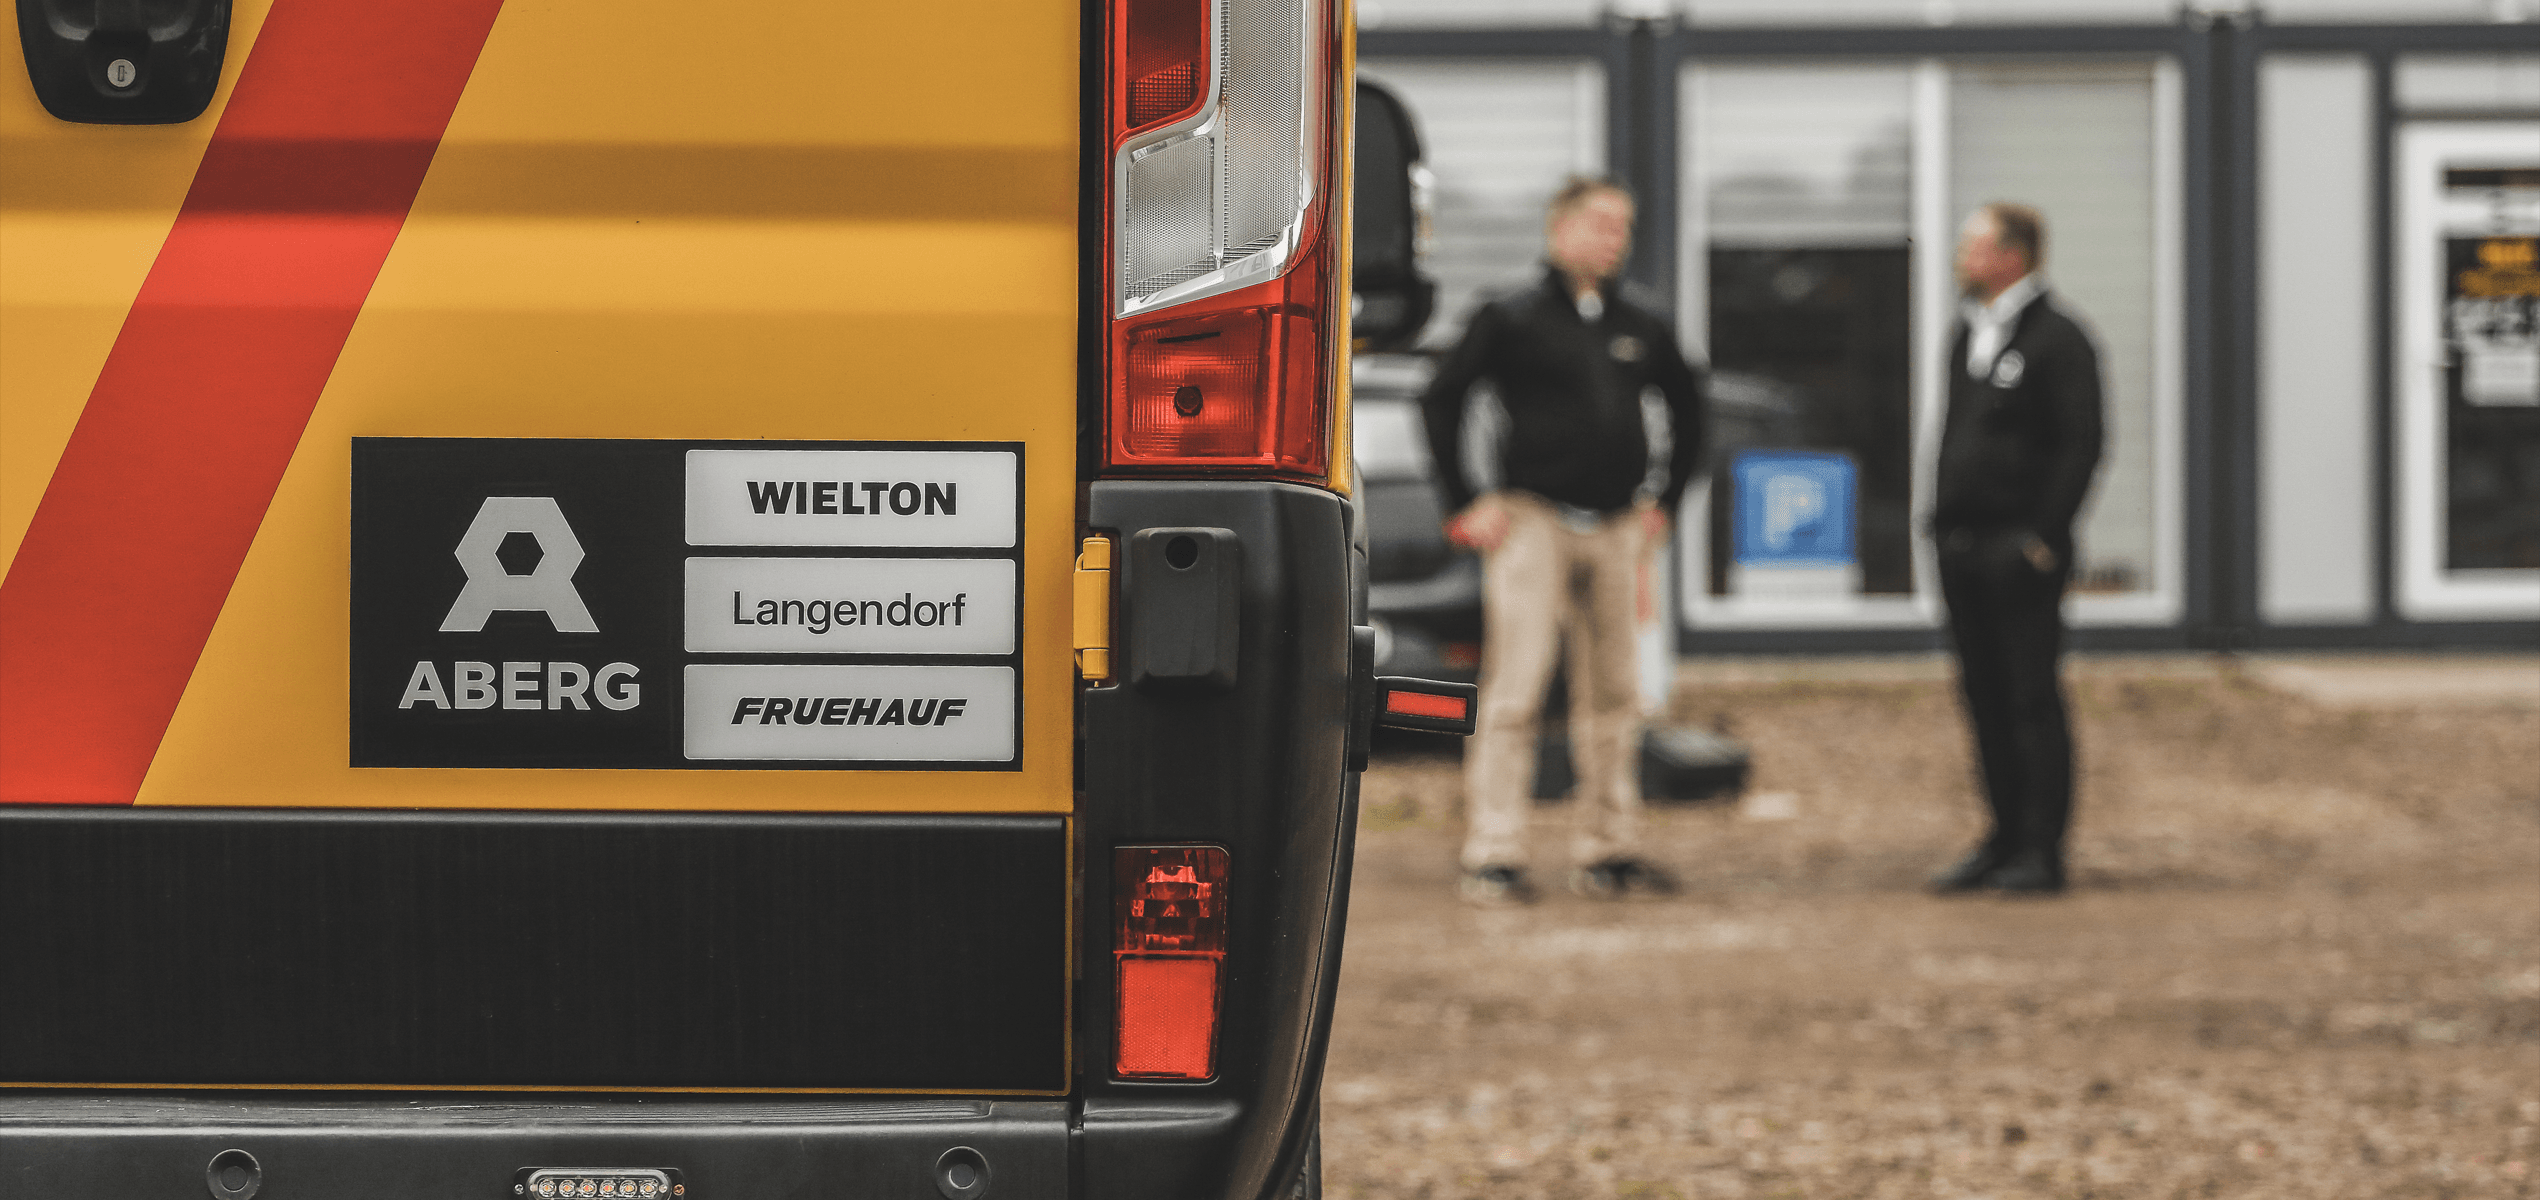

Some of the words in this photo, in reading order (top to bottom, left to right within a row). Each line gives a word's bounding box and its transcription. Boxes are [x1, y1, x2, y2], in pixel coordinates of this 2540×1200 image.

[746, 481, 957, 516] WIELTON
[1762, 473, 1827, 550] P
[733, 590, 967, 635] Langendorf
[398, 660, 640, 711] ABERG
[730, 697, 968, 726] FRUEHAUF
